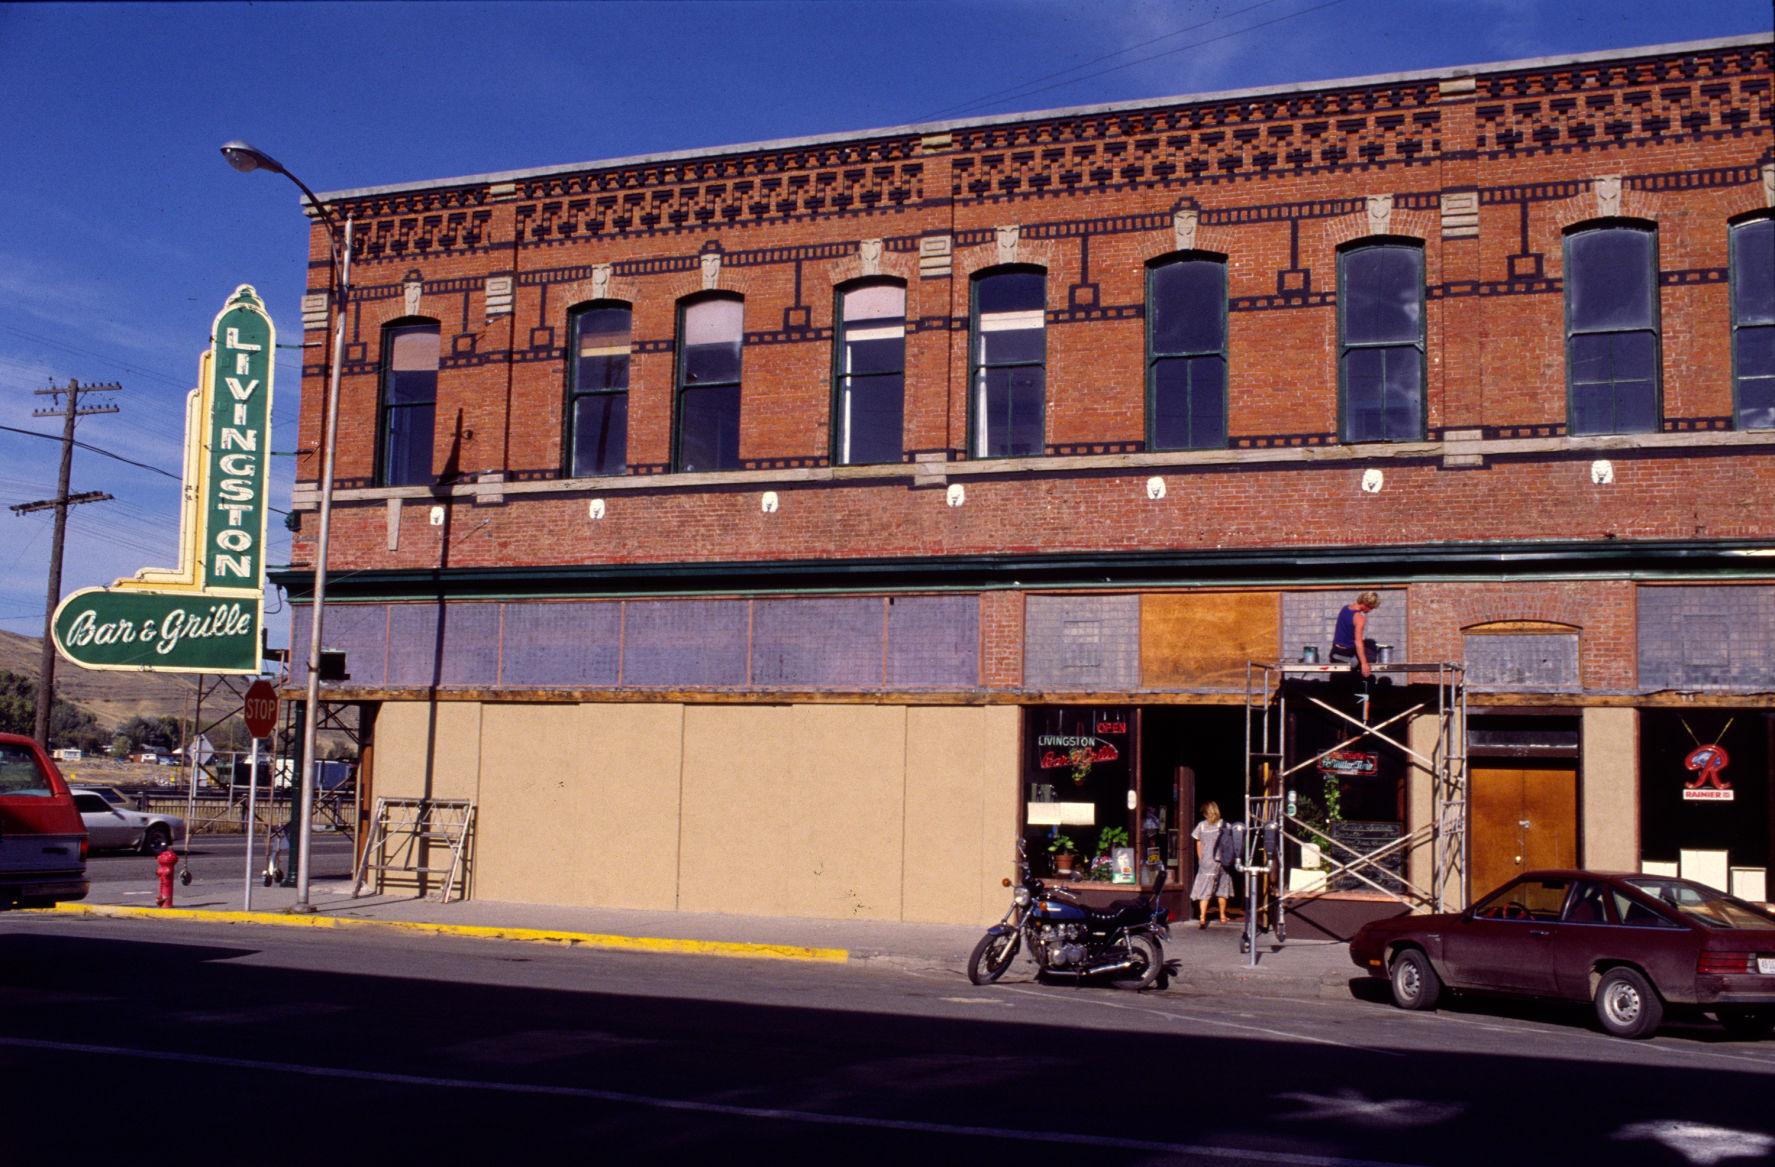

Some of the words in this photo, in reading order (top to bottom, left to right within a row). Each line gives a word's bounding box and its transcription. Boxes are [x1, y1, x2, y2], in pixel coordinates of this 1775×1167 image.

[214, 327, 262, 578] LIVINGSTON
[66, 609, 136, 647] Bar
[139, 619, 157, 642] &
[156, 603, 251, 654] Grille
[246, 698, 276, 720] STOP
[1096, 722, 1127, 734] OPEN
[1038, 735, 1096, 747] LIVINGSTON
